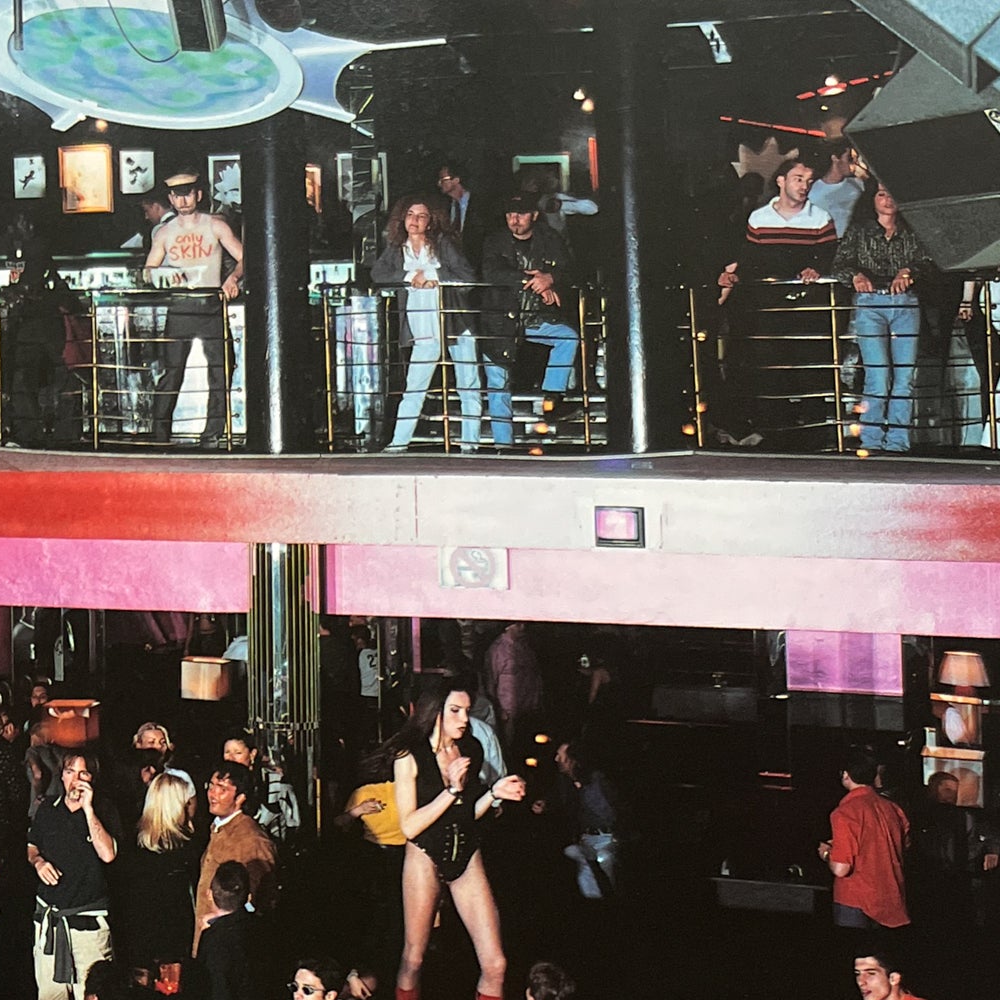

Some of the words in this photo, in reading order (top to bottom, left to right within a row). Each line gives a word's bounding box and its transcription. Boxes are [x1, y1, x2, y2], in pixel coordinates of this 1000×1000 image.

[175, 232, 204, 246] only
[169, 243, 213, 262] SKIN
[366, 652, 378, 669] 2
